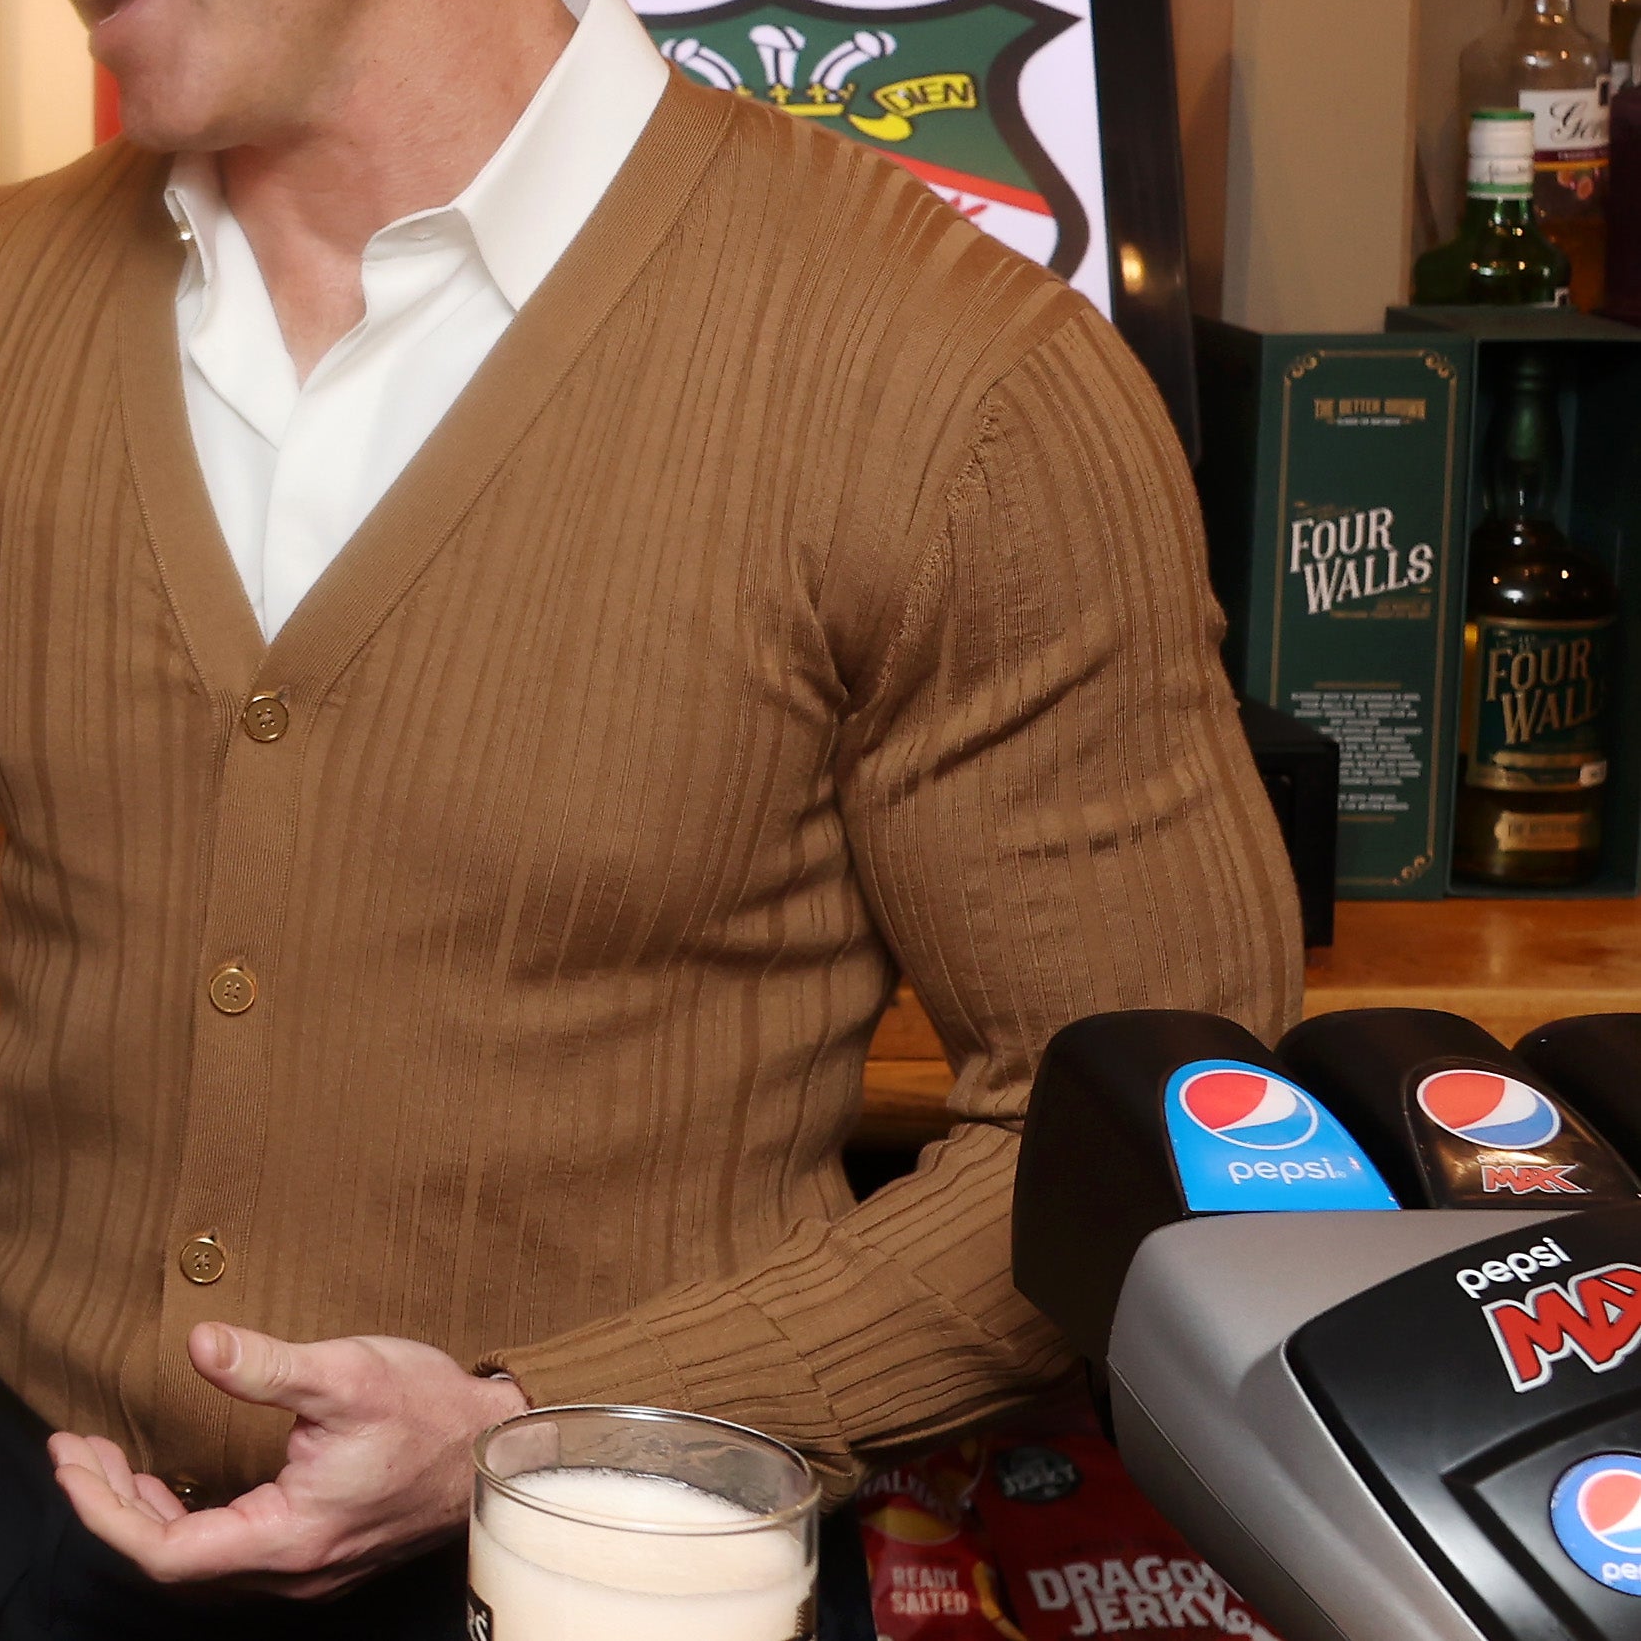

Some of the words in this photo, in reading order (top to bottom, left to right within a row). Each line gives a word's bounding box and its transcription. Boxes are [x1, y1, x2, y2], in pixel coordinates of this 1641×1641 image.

[1290, 507, 1395, 573] FOUR
[1303, 543, 1434, 615] WALLS
[1486, 638, 1592, 702] FOUR
[1228, 1157, 1337, 1185] pepsi
[1481, 1164, 1588, 1195] MAX
[1456, 1237, 1572, 1299] pepsi
[1481, 1262, 1641, 1393] MA
[889, 1589, 969, 1615] SALTED
[891, 1565, 958, 1588] READY
[1071, 1589, 1229, 1637] JERKY
